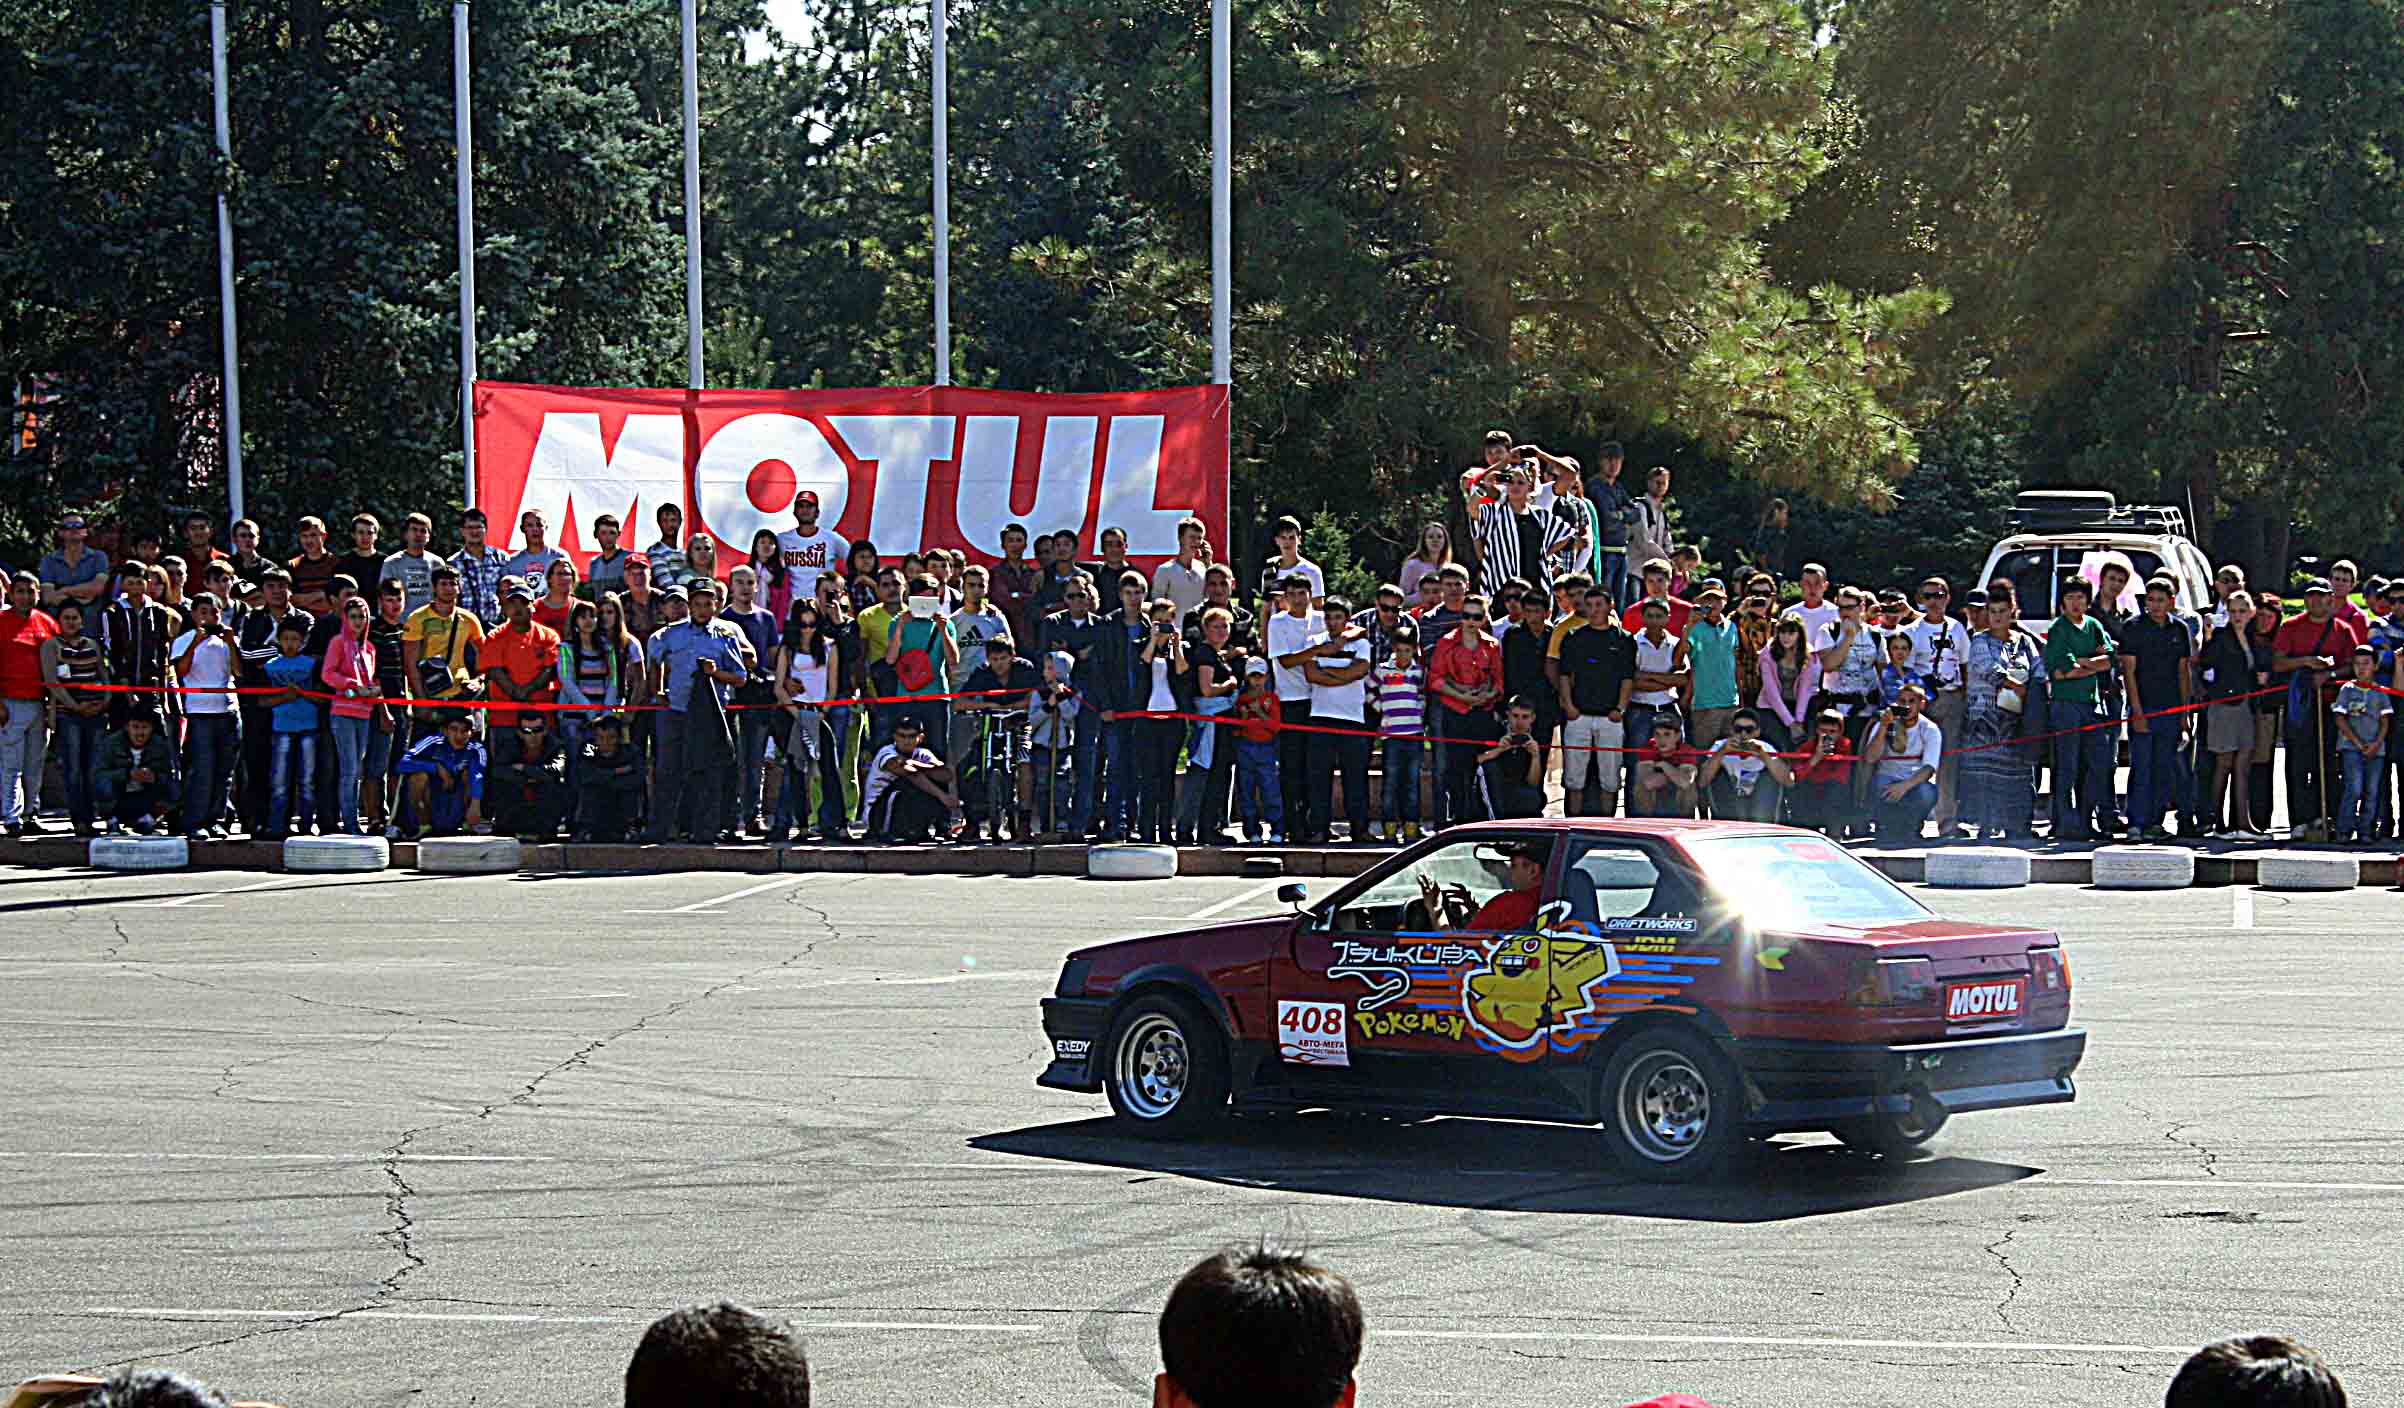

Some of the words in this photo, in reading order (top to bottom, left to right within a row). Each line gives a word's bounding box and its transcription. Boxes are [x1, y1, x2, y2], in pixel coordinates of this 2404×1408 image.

[508, 411, 1194, 559] MOTUL
[784, 550, 826, 568] RUSSIA
[1608, 919, 1693, 930] DRIFTWORKS
[1624, 936, 1677, 952] JDM
[1949, 985, 2018, 1016] MOTUL
[1280, 1007, 1342, 1034] 408
[1056, 1040, 1091, 1052] EXEDY
